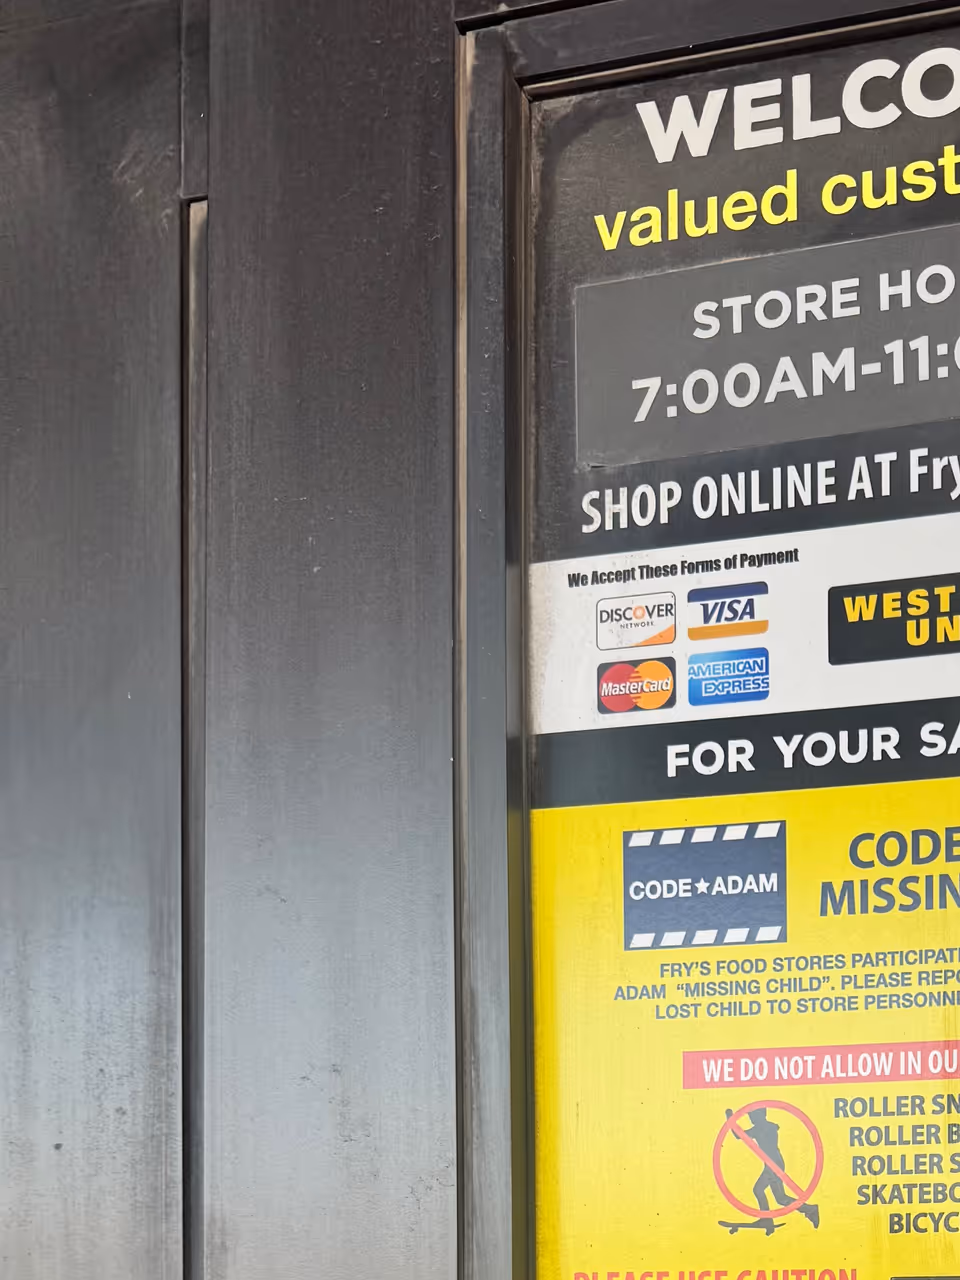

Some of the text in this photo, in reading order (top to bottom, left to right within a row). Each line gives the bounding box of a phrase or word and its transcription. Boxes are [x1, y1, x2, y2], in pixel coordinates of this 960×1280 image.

[594, 169, 797, 250] valued
[693, 278, 860, 338] STORE
[582, 481, 681, 533] SHOP
[693, 460, 836, 519] ONLINE
[848, 452, 897, 500] AT
[568, 548, 799, 587] We Accept These Forms of Payment
[600, 603, 674, 623] DISCOVER
[700, 598, 754, 624] VISA
[688, 659, 764, 678] AMERICAN
[601, 677, 671, 697] MasterCard
[702, 677, 769, 696] EXPRESS
[667, 739, 755, 777] FOR
[773, 727, 900, 768] YOUR
[660, 961, 710, 978] FRY'S
[716, 959, 767, 975] FOOD
[773, 955, 846, 973] STORES
[703, 1059, 734, 1082] WE
[741, 1057, 768, 1081] DO
[775, 1056, 815, 1079] NOT
[821, 1052, 893, 1078] ALLOW
[900, 1051, 921, 1074] IN
[834, 1096, 925, 1118] ROLLER
[849, 1125, 940, 1146] ROLLER
[852, 1154, 943, 1176] ROLLER
